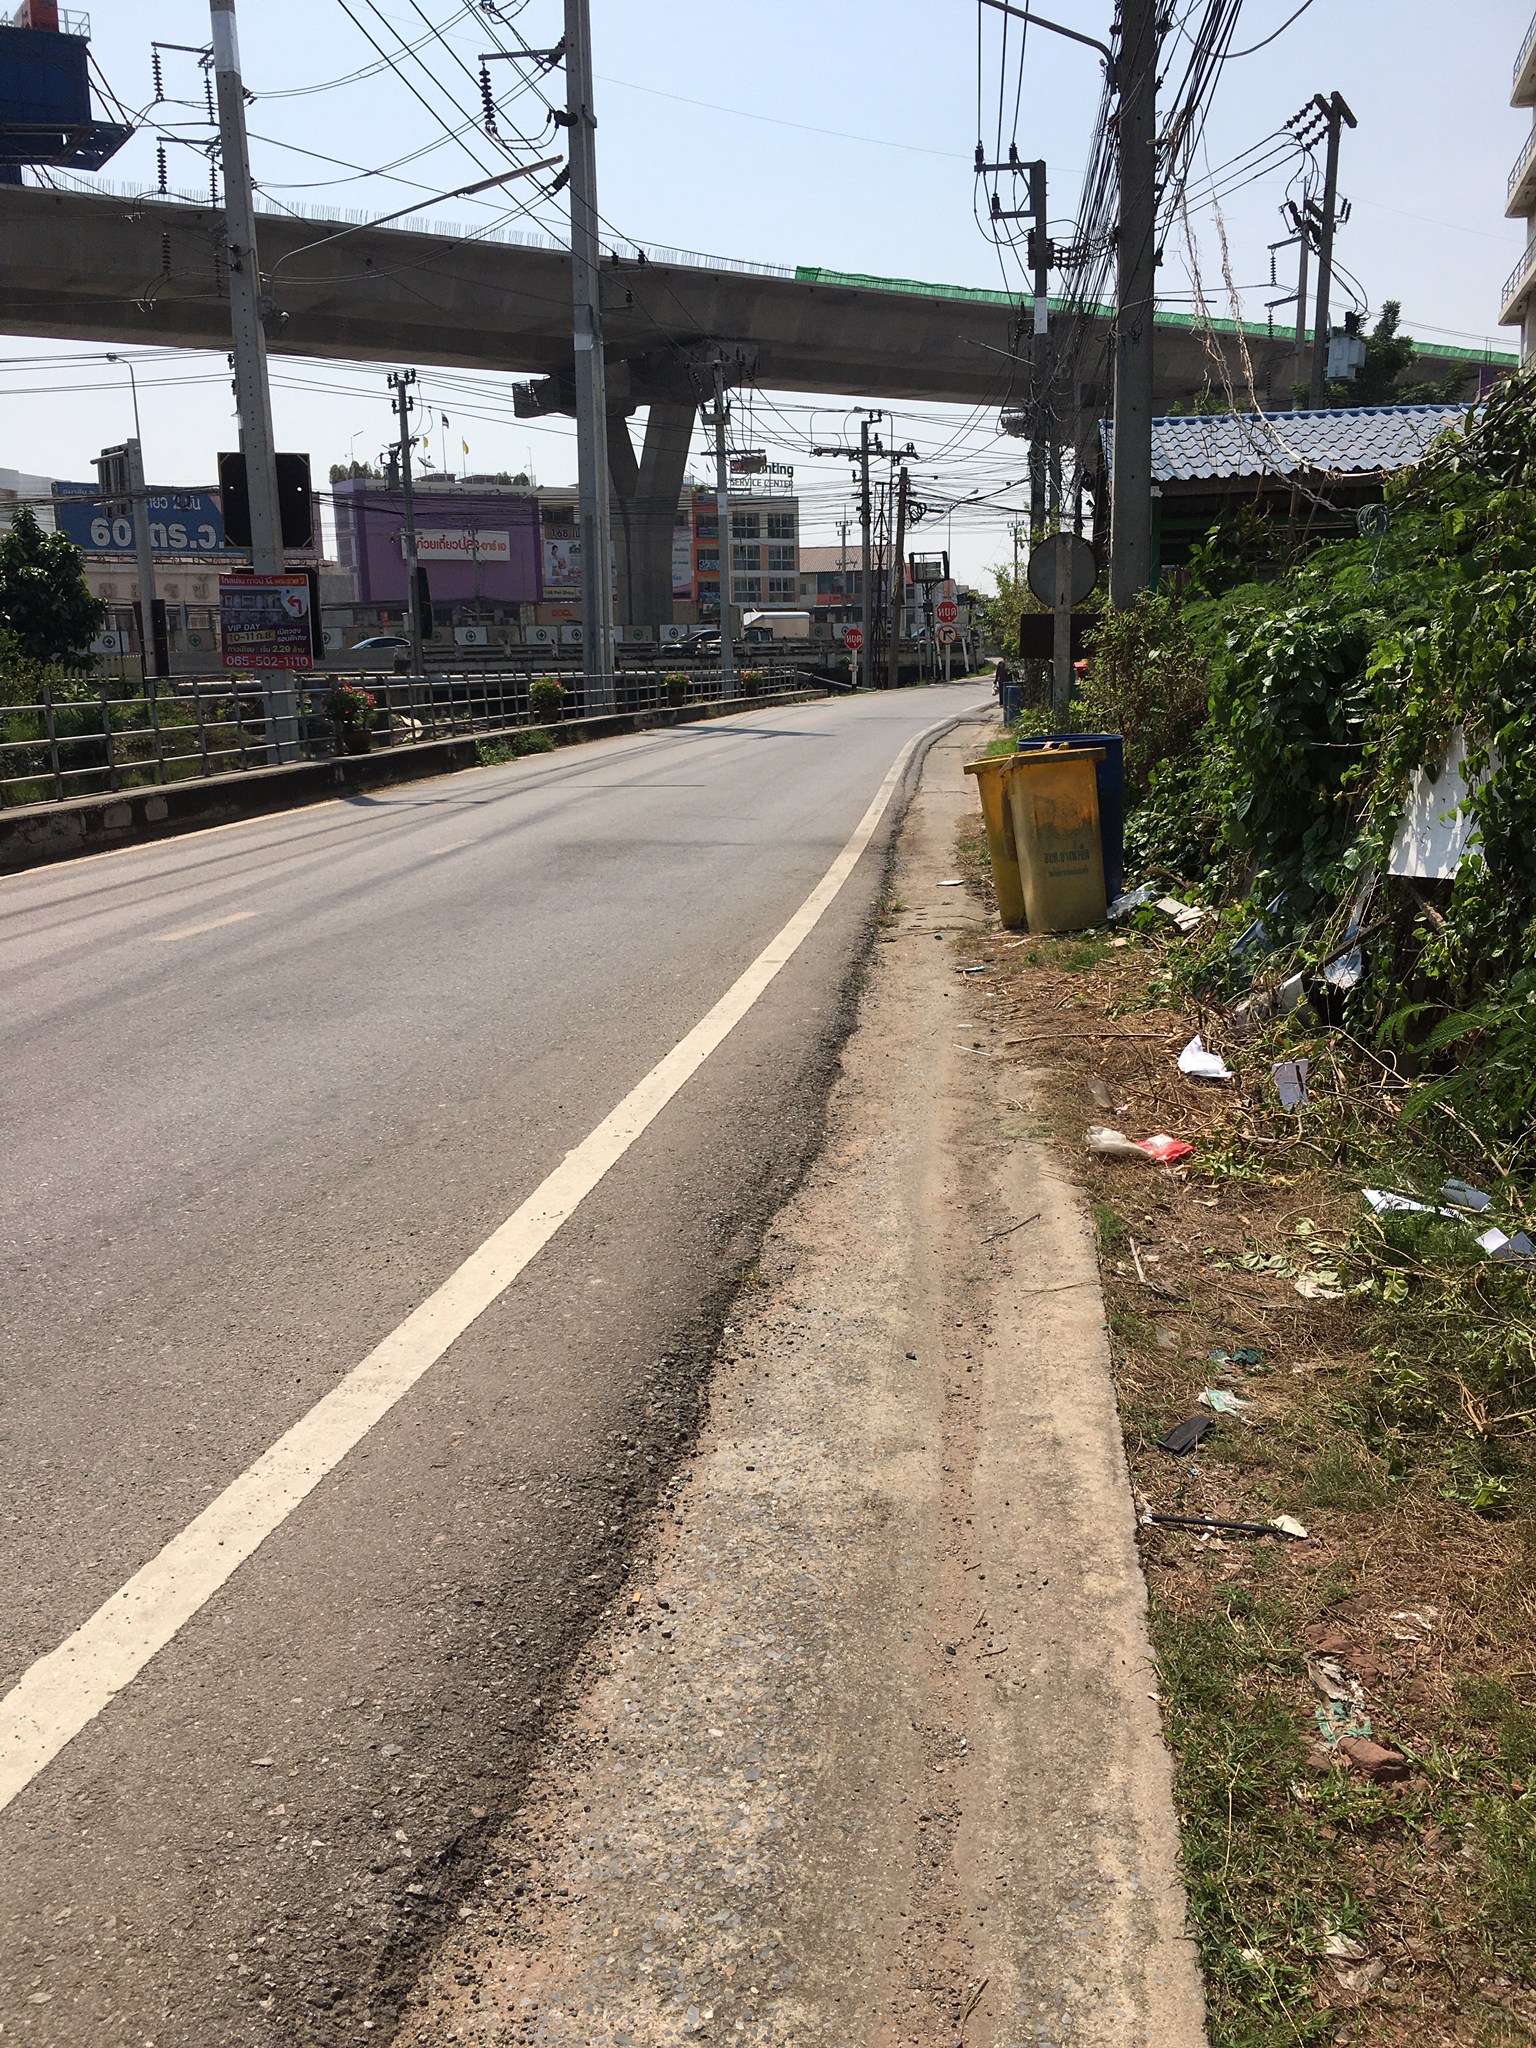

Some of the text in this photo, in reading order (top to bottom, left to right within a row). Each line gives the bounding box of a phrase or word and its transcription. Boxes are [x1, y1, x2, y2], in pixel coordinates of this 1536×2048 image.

[730, 478, 794, 488] SERVICE CENTER
[90, 517, 132, 547] 60
[551, 528, 569, 538] 168
[938, 607, 957, 620] หยุด
[227, 623, 261, 632] VIP DAY
[229, 632, 254, 642] 10-11
[846, 634, 862, 646] หยุด
[226, 655, 309, 667] 065-502-1110
